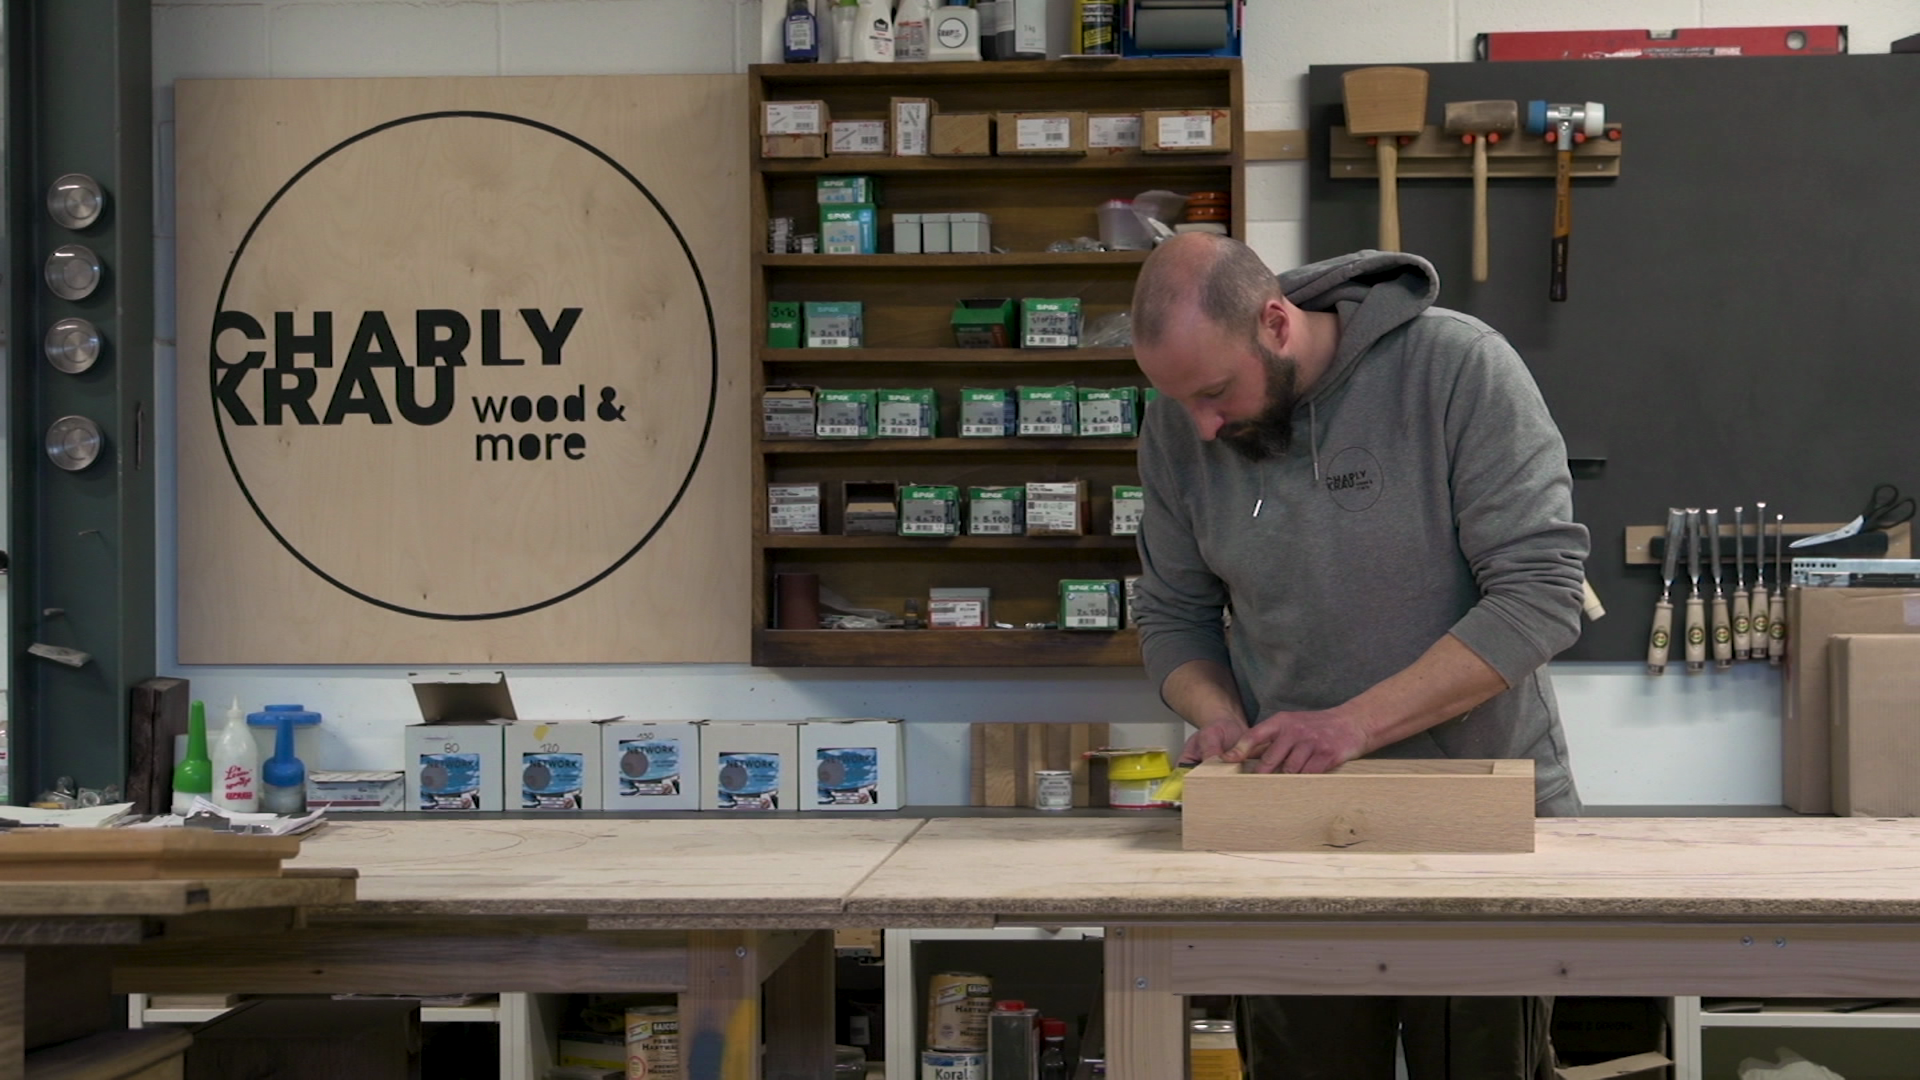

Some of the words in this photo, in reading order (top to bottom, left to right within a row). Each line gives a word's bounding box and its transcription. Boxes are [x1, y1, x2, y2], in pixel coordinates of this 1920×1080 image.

[211, 307, 583, 368] CHARLY
[211, 365, 455, 426] KRAU
[472, 384, 586, 423] wood
[597, 386, 626, 422] &
[476, 433, 587, 462] more
[444, 742, 460, 753] 80
[540, 742, 560, 753] 120
[627, 745, 675, 755] NETWORK
[427, 759, 474, 769] NETWORK
[530, 759, 578, 769] NETWORK
[726, 759, 775, 769] NETWORK
[825, 754, 872, 764] NETWORK
